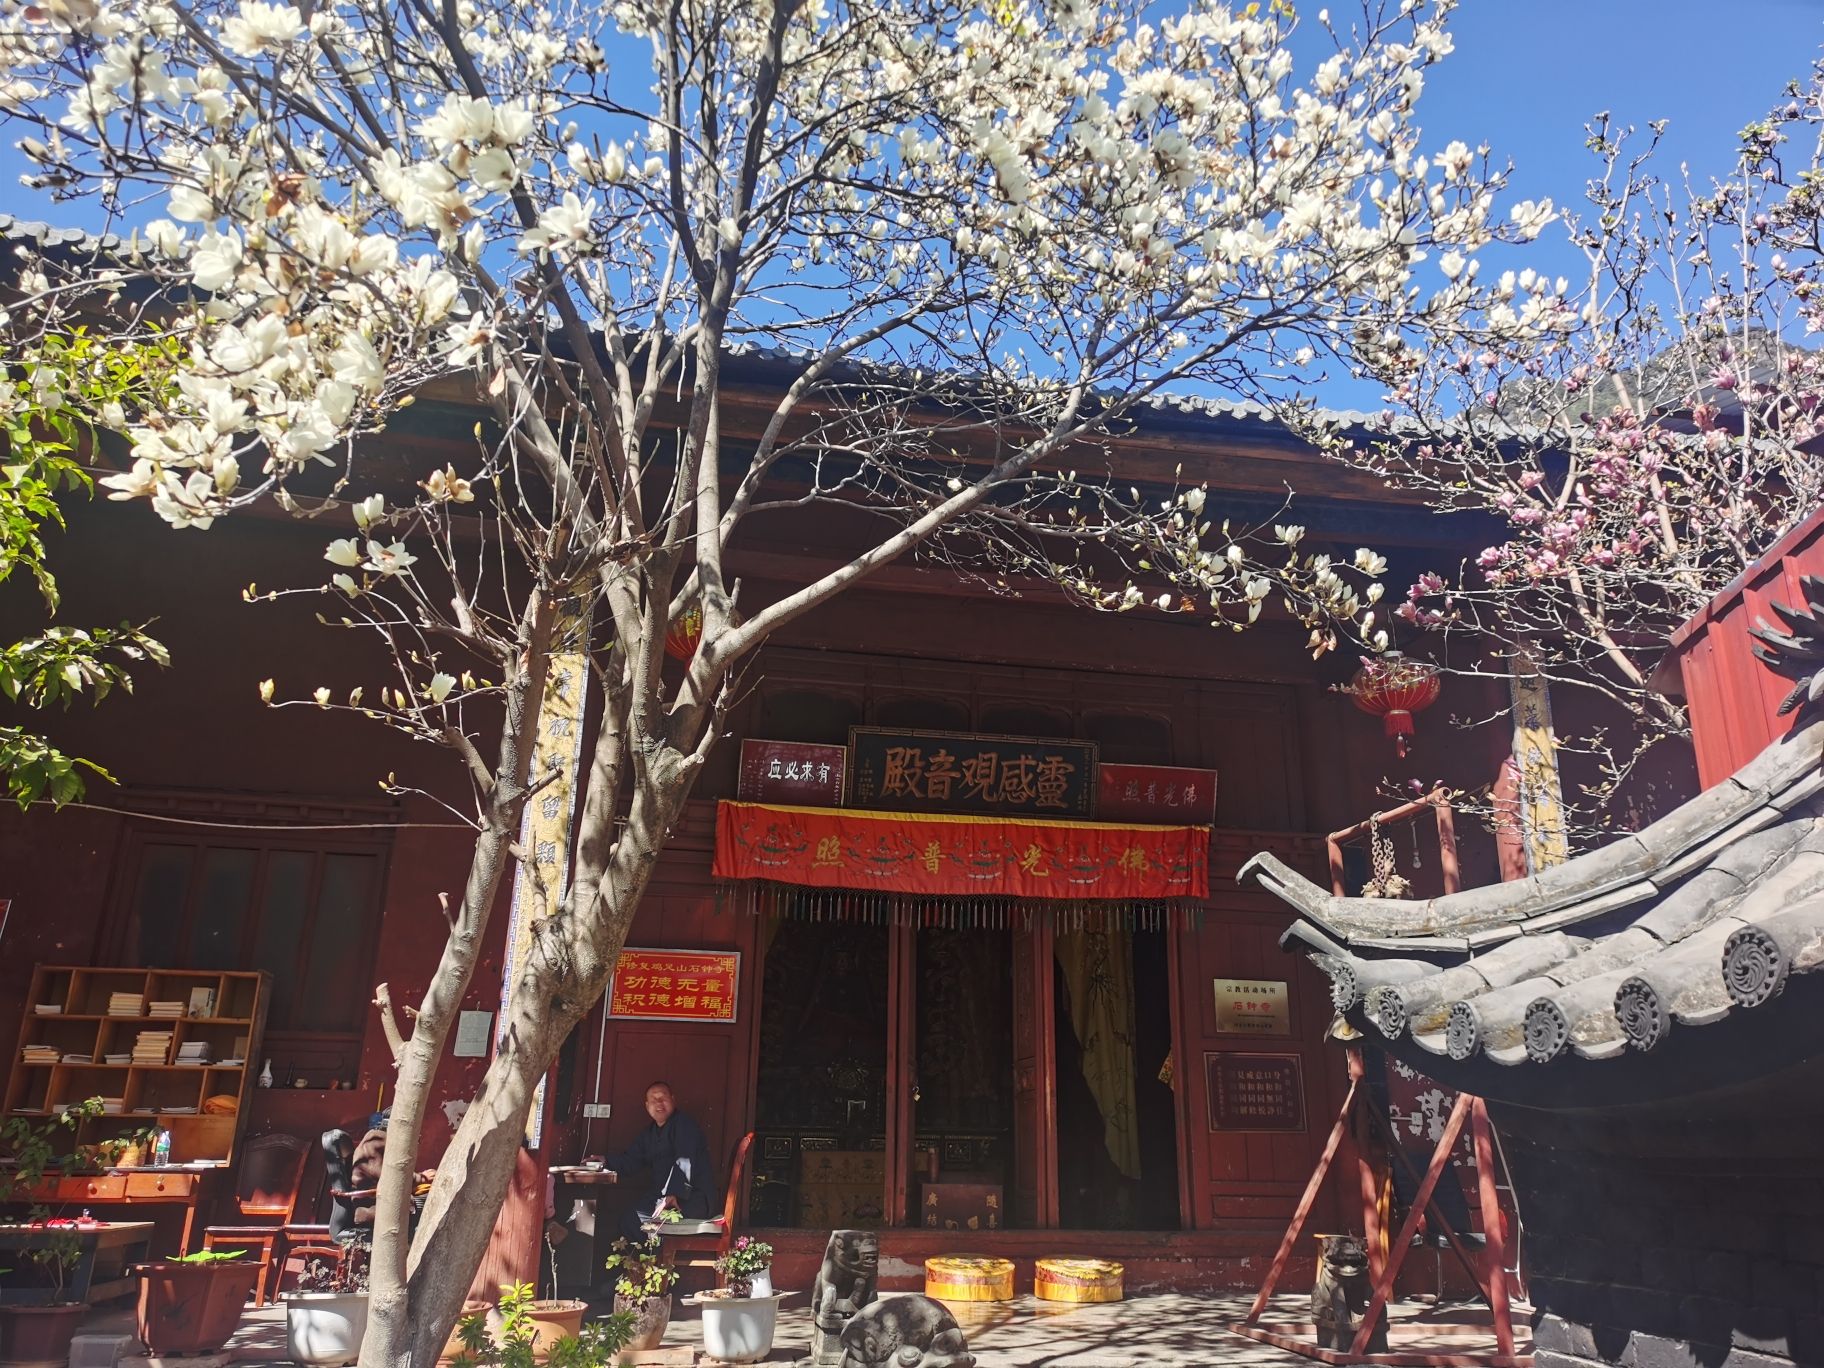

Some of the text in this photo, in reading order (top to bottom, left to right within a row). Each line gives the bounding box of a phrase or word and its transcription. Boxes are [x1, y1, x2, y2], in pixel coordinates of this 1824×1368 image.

[811, 836, 1151, 878] 佛光普照
[623, 976, 725, 993] 功德无量
